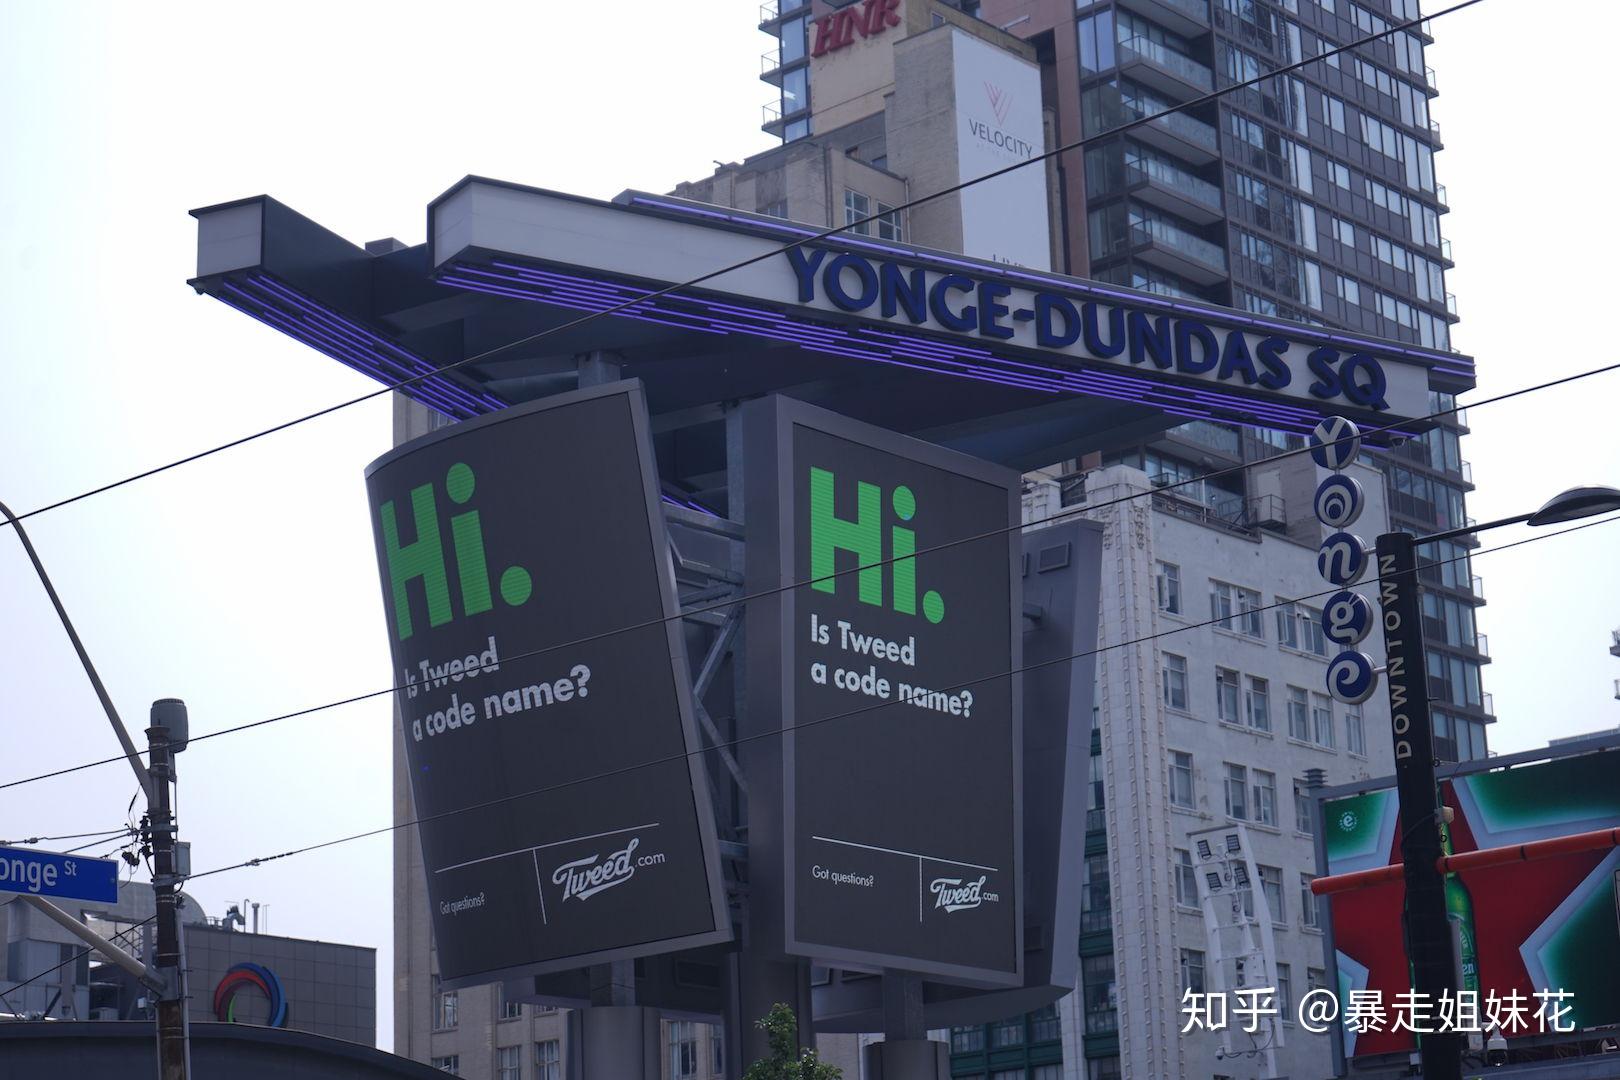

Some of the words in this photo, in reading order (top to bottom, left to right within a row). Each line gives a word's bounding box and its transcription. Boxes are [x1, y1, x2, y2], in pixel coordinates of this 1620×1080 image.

[968, 118, 1033, 160] VELOCITY
[786, 245, 1292, 391] YONGE-DUNDAS
[1309, 344, 1388, 412] SQ
[380, 461, 533, 642] Hi.
[810, 465, 945, 625] Hi.
[404, 667, 419, 700] Is
[418, 635, 501, 694] Tweed
[810, 613, 831, 646] Is
[837, 619, 917, 667] Tweed
[1379, 552, 1413, 761] DOWNTOWN
[412, 718, 424, 743] a
[425, 693, 477, 738] code
[483, 664, 593, 721] name?
[810, 661, 828, 686] a
[833, 665, 892, 700] code
[898, 681, 975, 719] name?
[0, 857, 58, 892] onge
[64, 860, 78, 877] St
[439, 900, 451, 916] Got
[451, 891, 487, 916] questions?
[811, 864, 830, 880] Got
[831, 873, 875, 888] questions?
